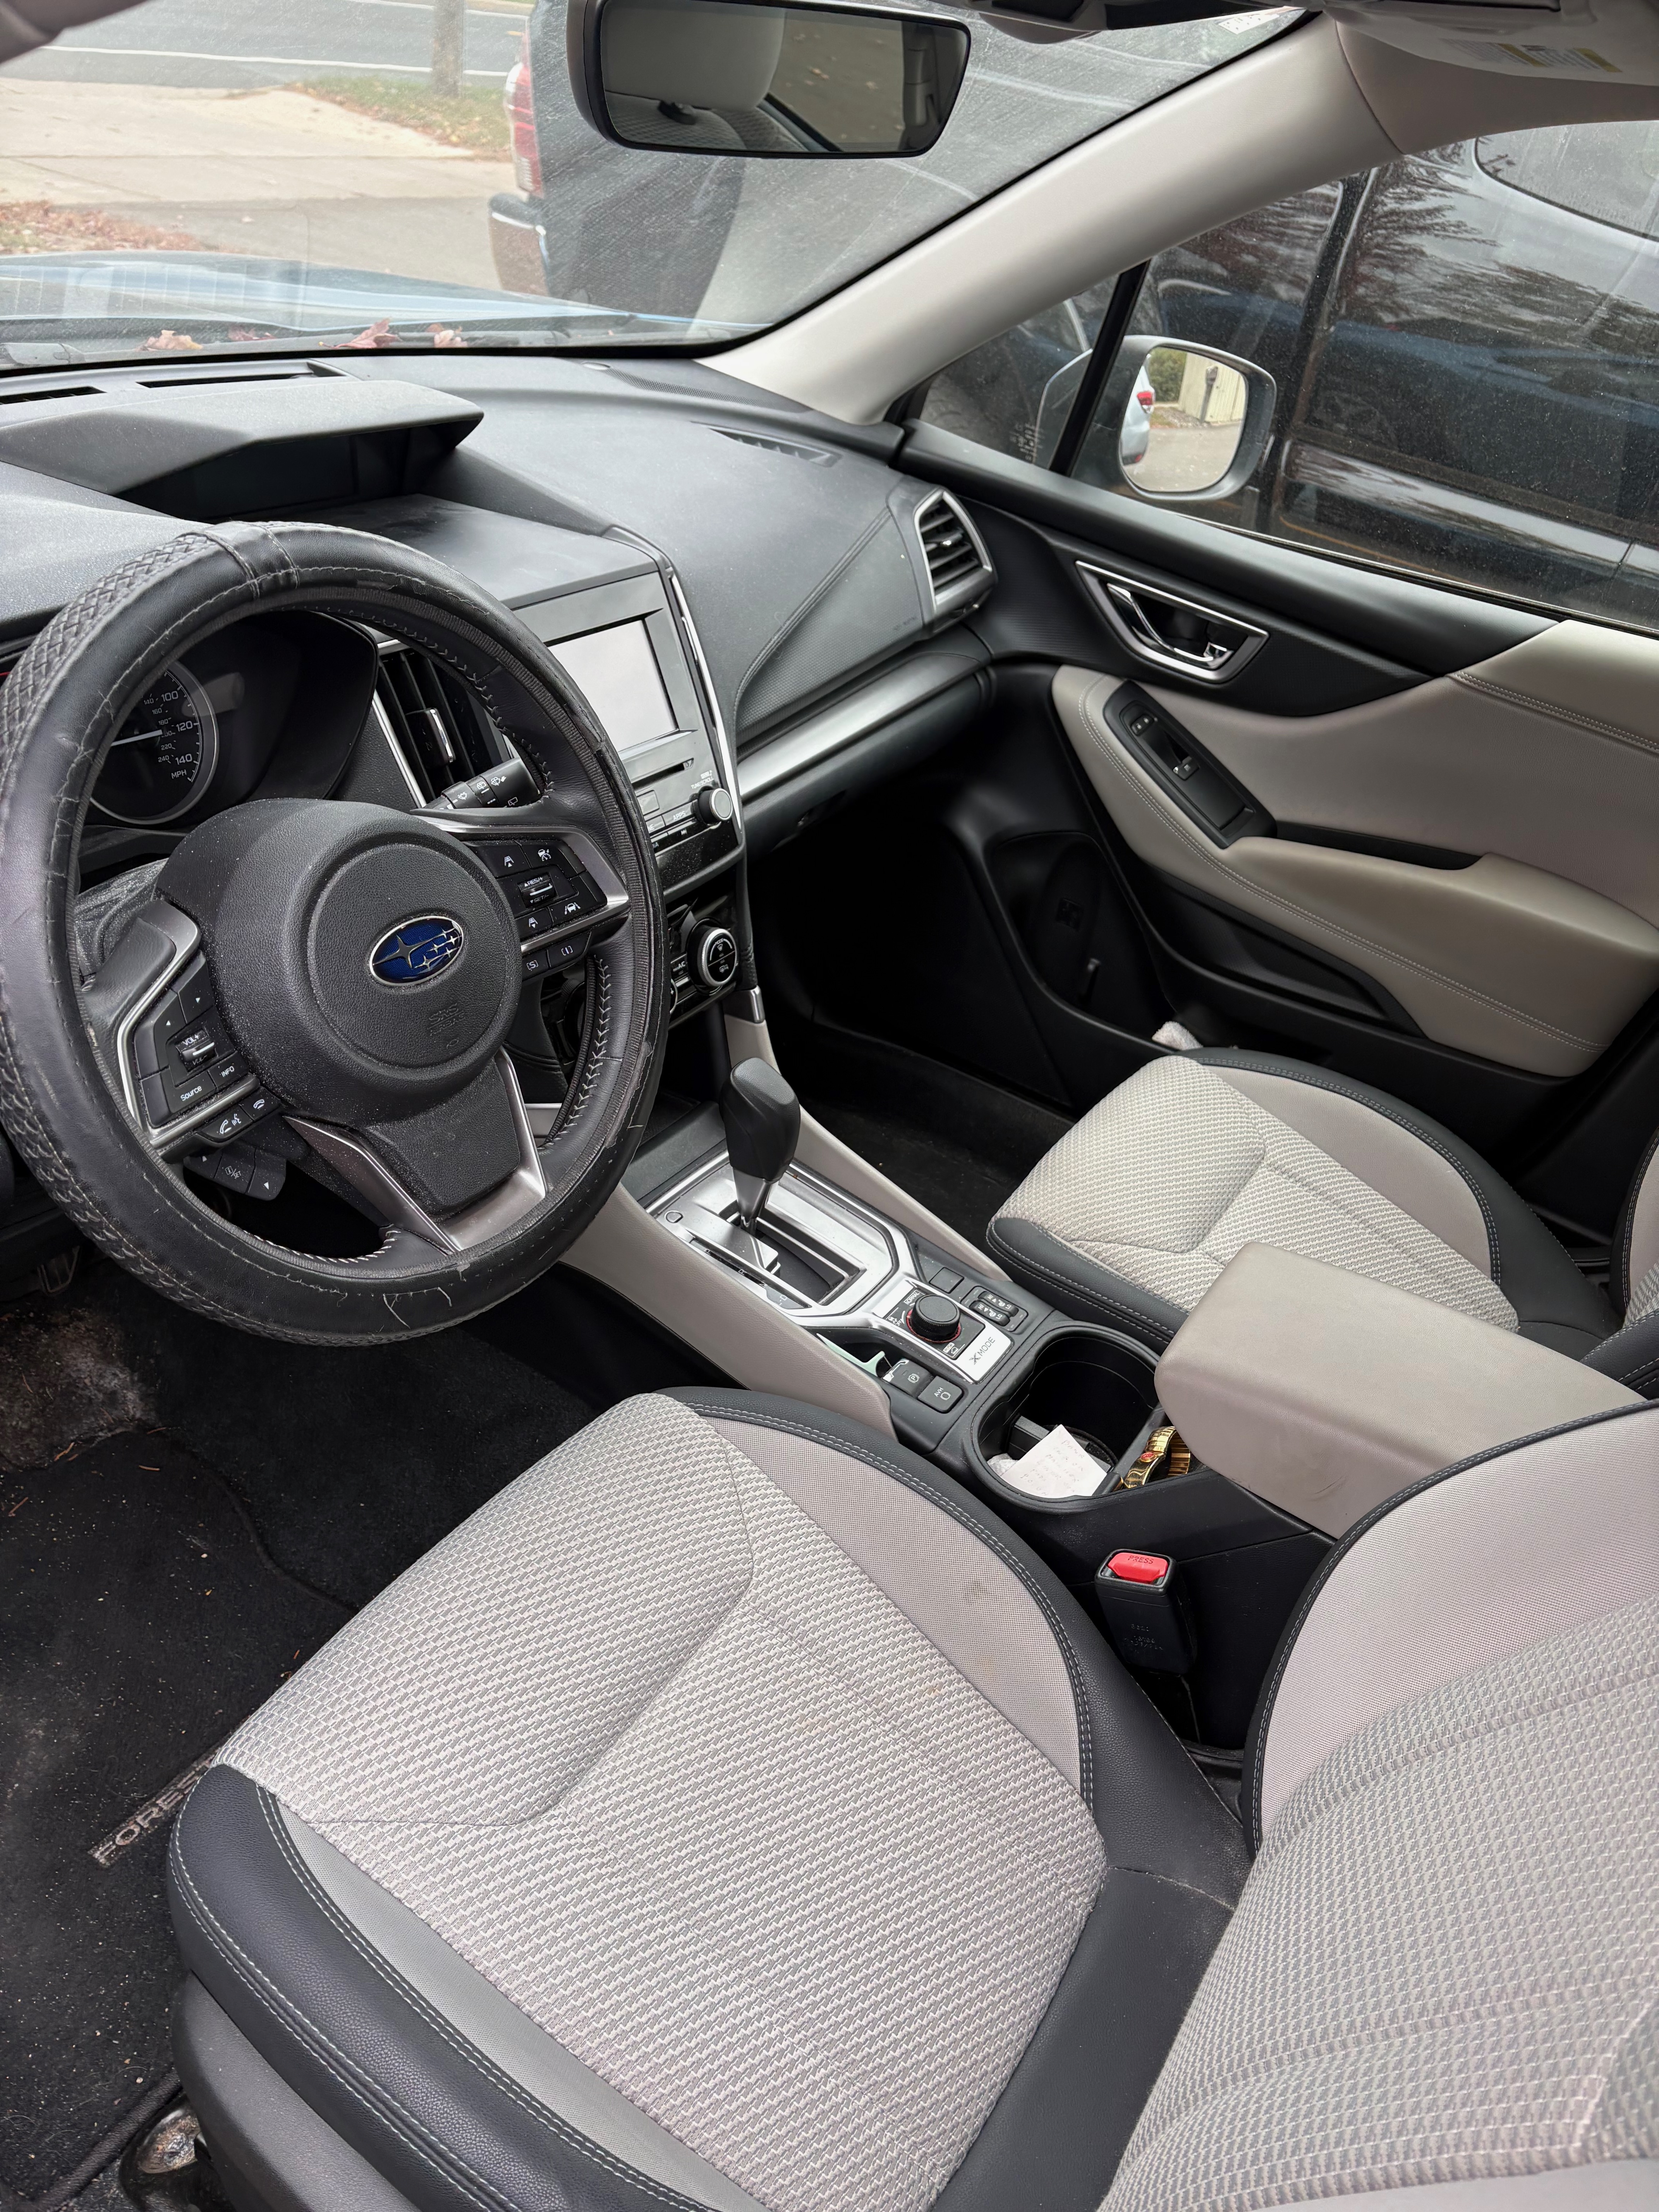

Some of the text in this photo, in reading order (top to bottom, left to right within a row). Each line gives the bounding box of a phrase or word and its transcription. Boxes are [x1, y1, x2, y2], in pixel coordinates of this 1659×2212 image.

[161, 690, 179, 702] 100
[176, 721, 193, 732] 120
[175, 753, 192, 765] 140
[171, 769, 187, 779] MPH
[673, 811, 686, 821] APPS
[221, 1066, 235, 1077] INFO
[180, 1085, 202, 1101] Source
[977, 1337, 996, 1356] MODE
[934, 1387, 944, 1397] AVH
[1128, 1555, 1154, 1564] PRESS
